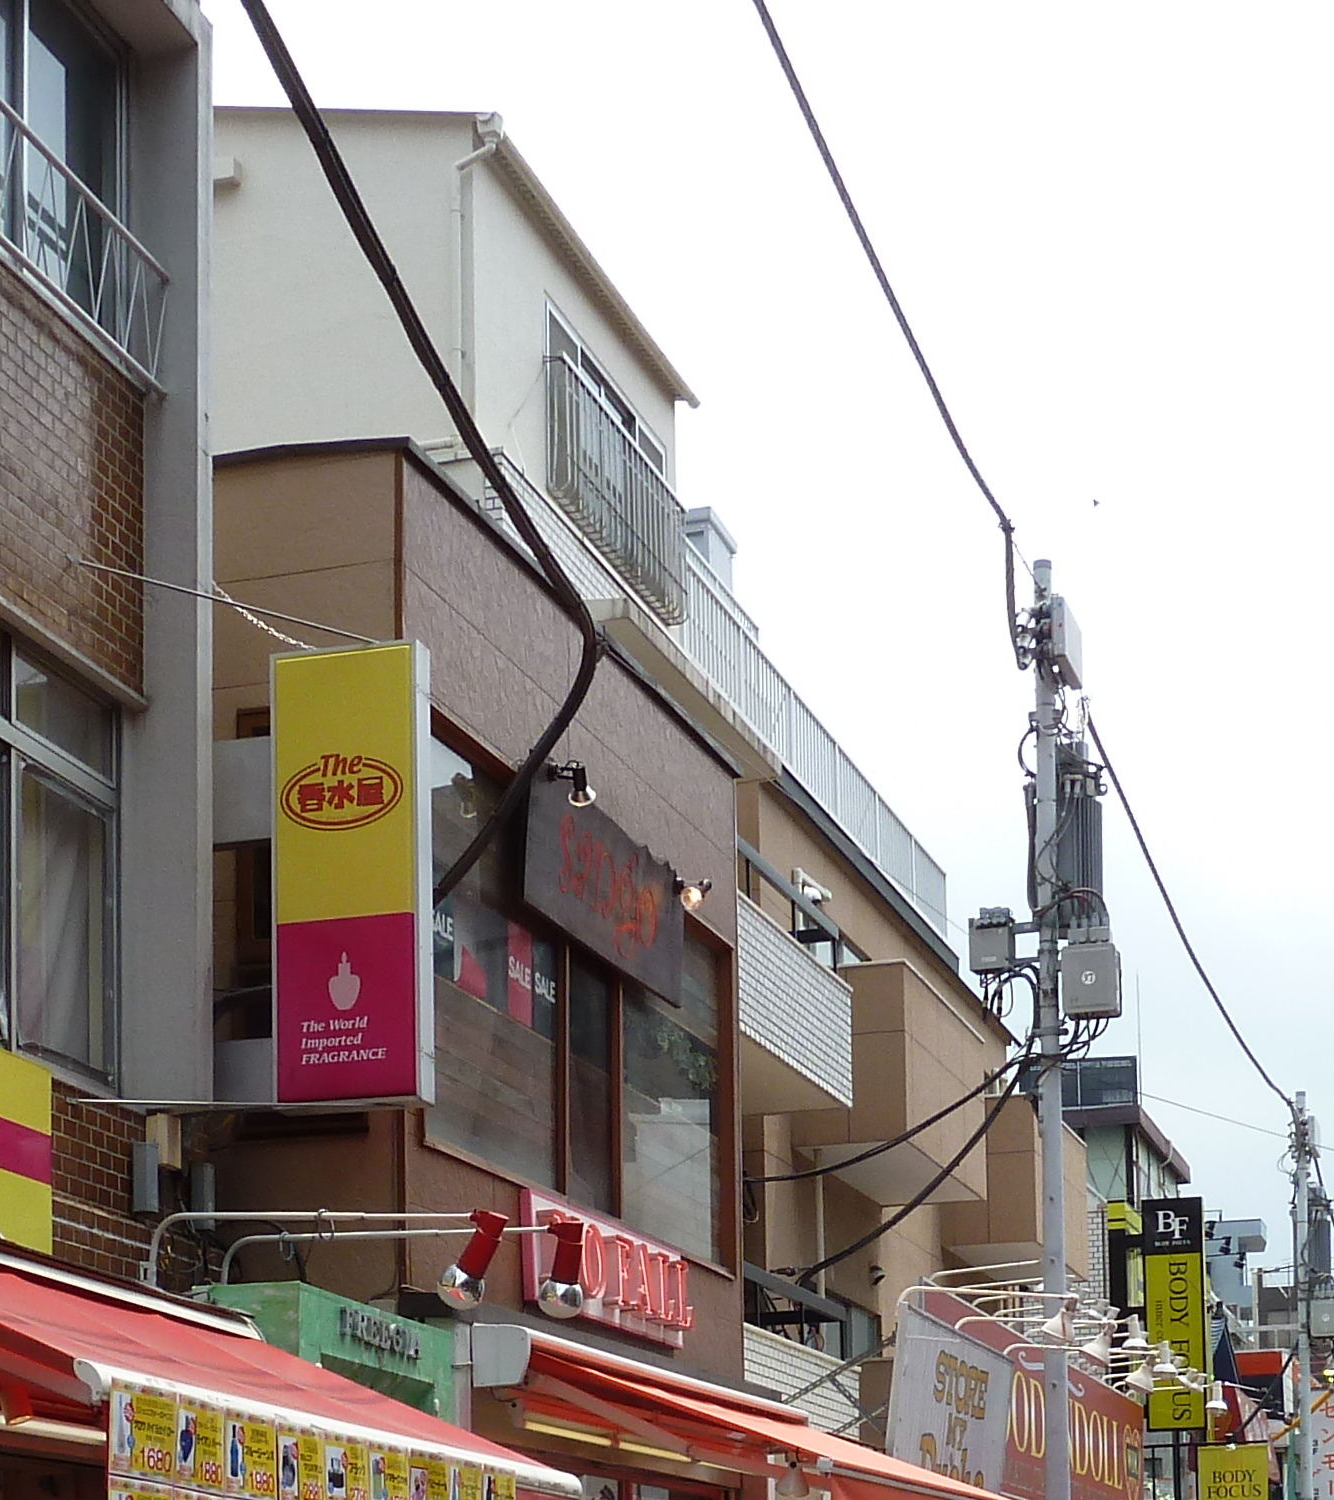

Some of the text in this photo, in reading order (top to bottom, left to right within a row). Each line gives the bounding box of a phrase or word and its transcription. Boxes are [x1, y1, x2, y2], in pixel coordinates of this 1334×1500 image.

[319, 753, 365, 777] The
[297, 776, 385, 814] 香水屋
[508, 956, 532, 990] SALE
[534, 972, 556, 1004] SALE
[300, 1015, 369, 1034] The World
[300, 1032, 363, 1051] Imported
[300, 1047, 388, 1066] FRAGRANCE
[1155, 1209, 1190, 1240] BF
[1168, 1260, 1190, 1329] BODY
[933, 1349, 989, 1420] STORE
[1171, 1337, 1193, 1423] FOUS
[1207, 1484, 1262, 1500] FOCUS
[1211, 1469, 1257, 1485] BODY
